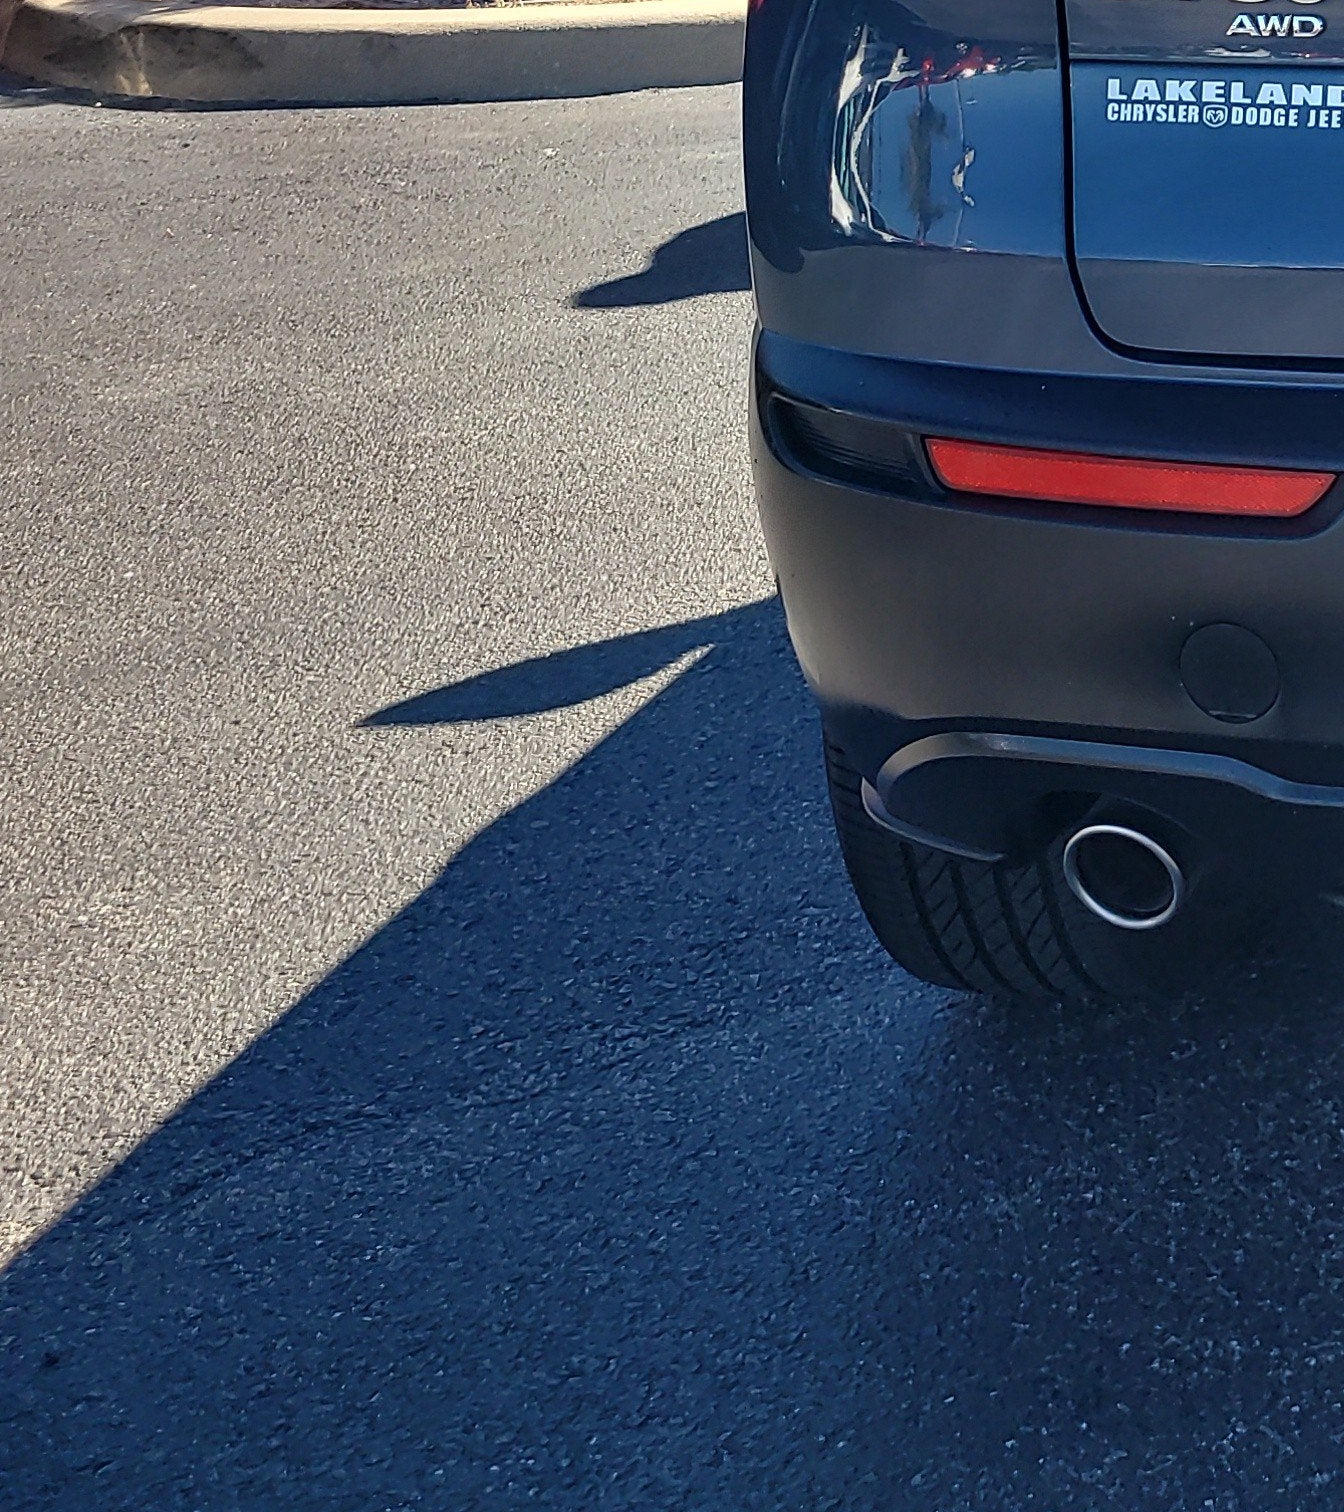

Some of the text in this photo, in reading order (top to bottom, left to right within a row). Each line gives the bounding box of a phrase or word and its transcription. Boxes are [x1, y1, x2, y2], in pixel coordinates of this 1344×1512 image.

[1225, 14, 1325, 38] AWD
[1106, 103, 1200, 124] CHRYSLER
[1231, 106, 1299, 127] DODGE
